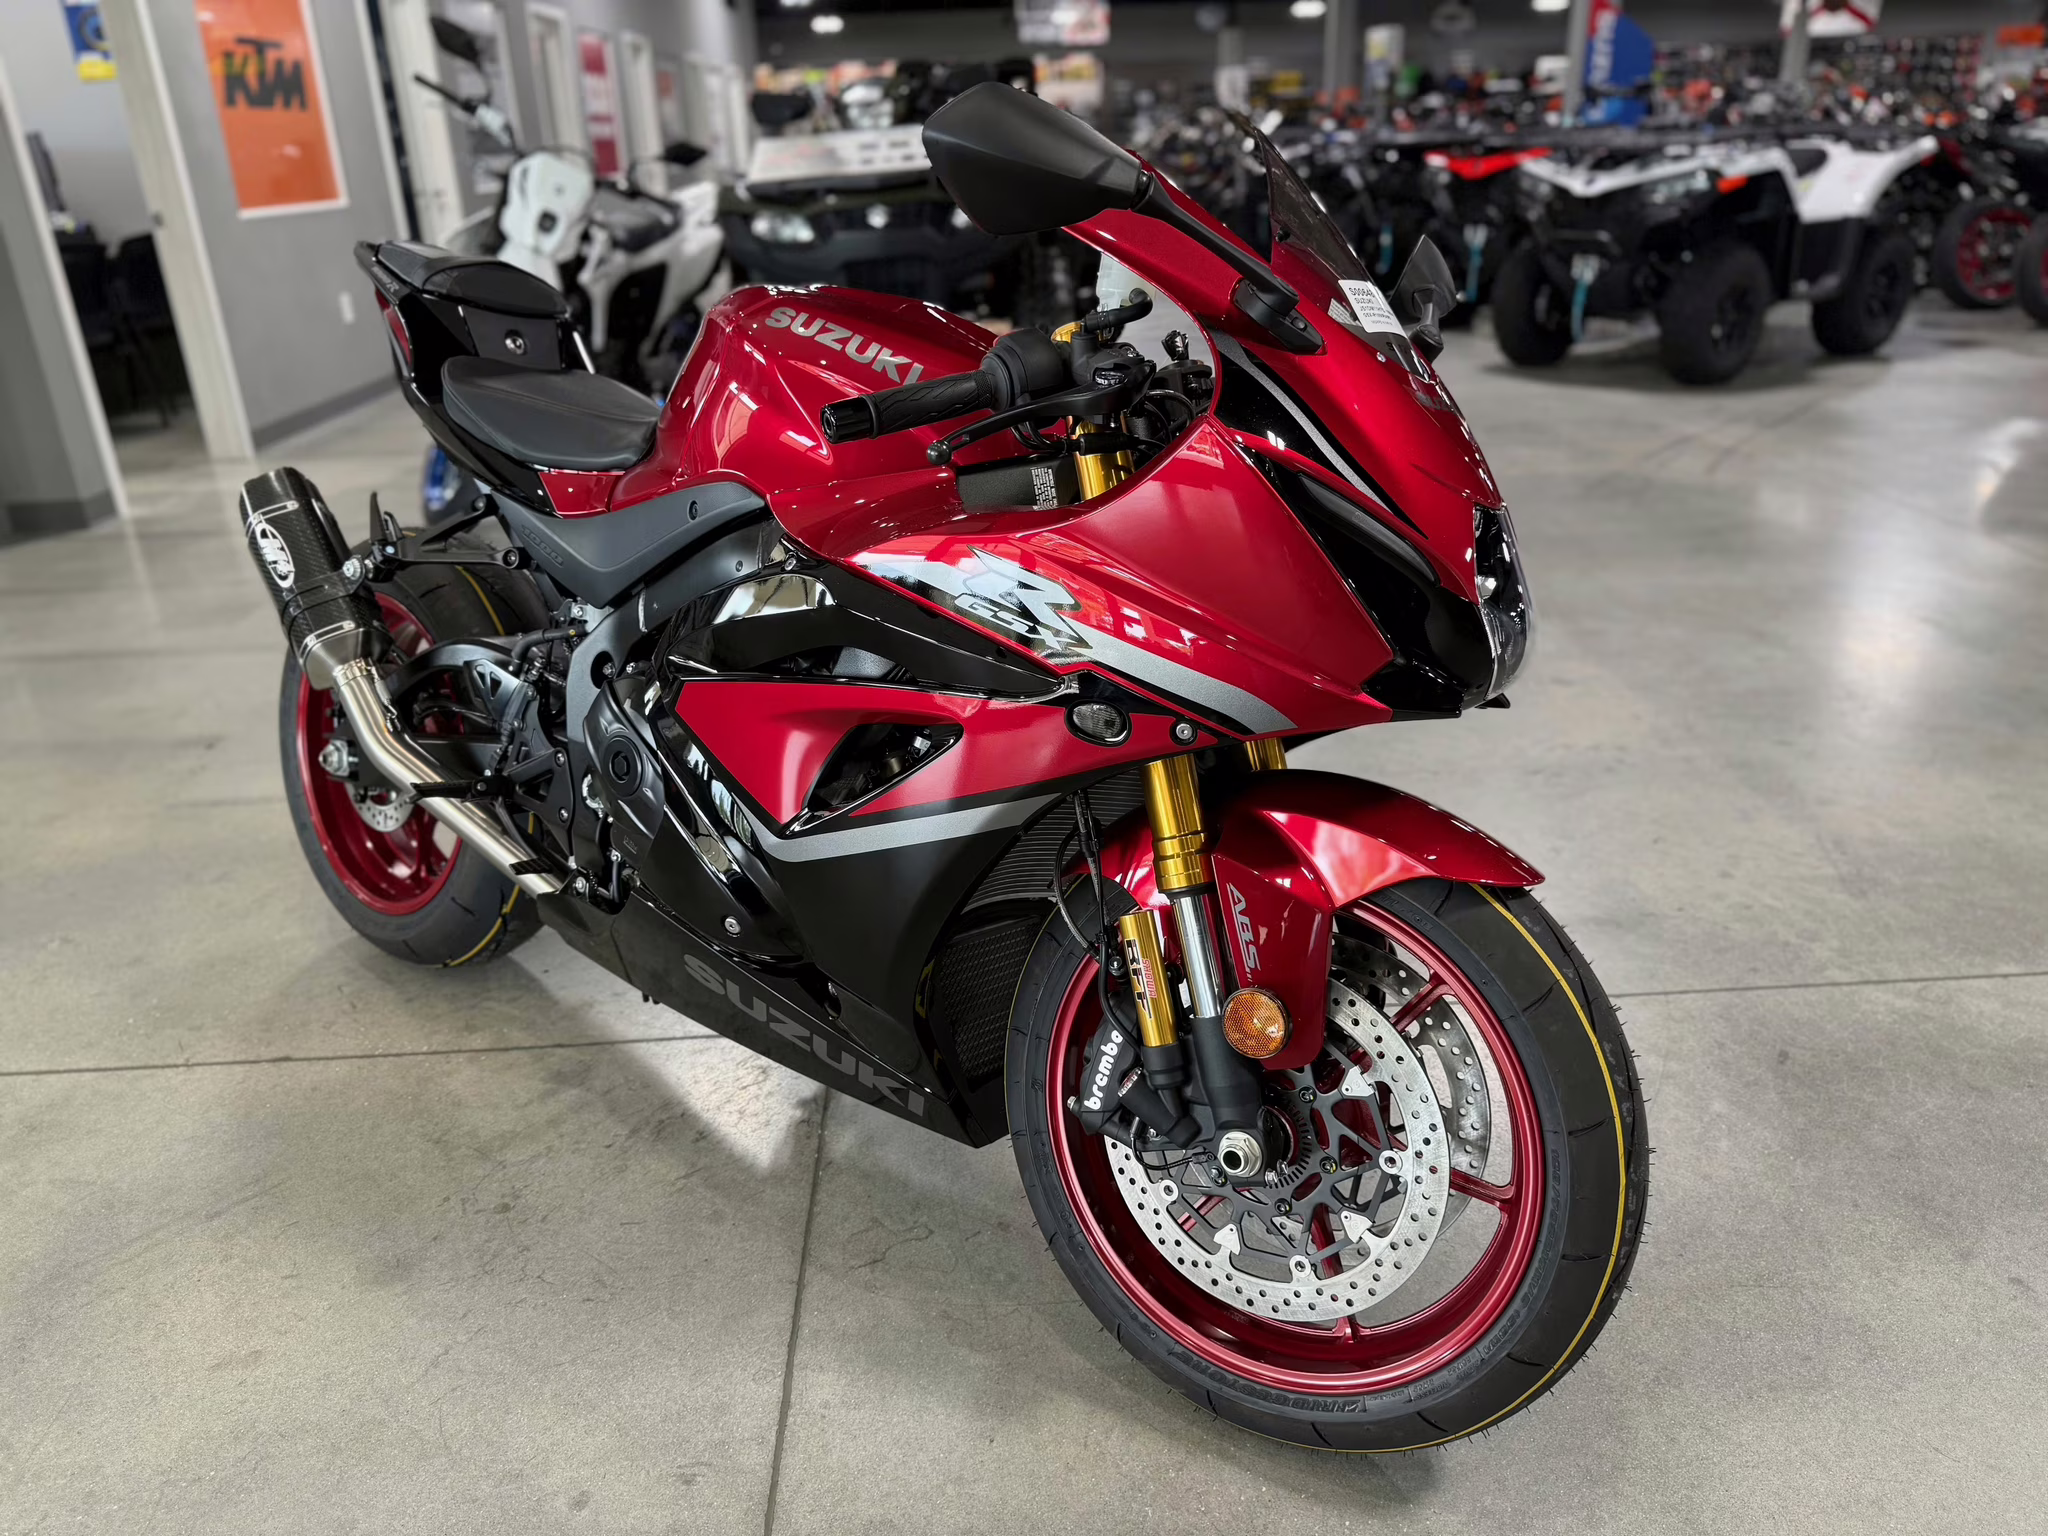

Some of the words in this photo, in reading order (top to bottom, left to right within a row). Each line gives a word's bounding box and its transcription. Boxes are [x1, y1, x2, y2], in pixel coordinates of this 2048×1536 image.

[224, 36, 307, 111] KTM
[765, 306, 924, 386] SUZUKI
[1226, 882, 1261, 978] ABS
[1140, 957, 1157, 999] SHOWA
[683, 953, 925, 1117] SUZUKI
[1083, 1029, 1124, 1110] brembo
[1172, 1351, 1366, 1413] BRIDGESTONE
